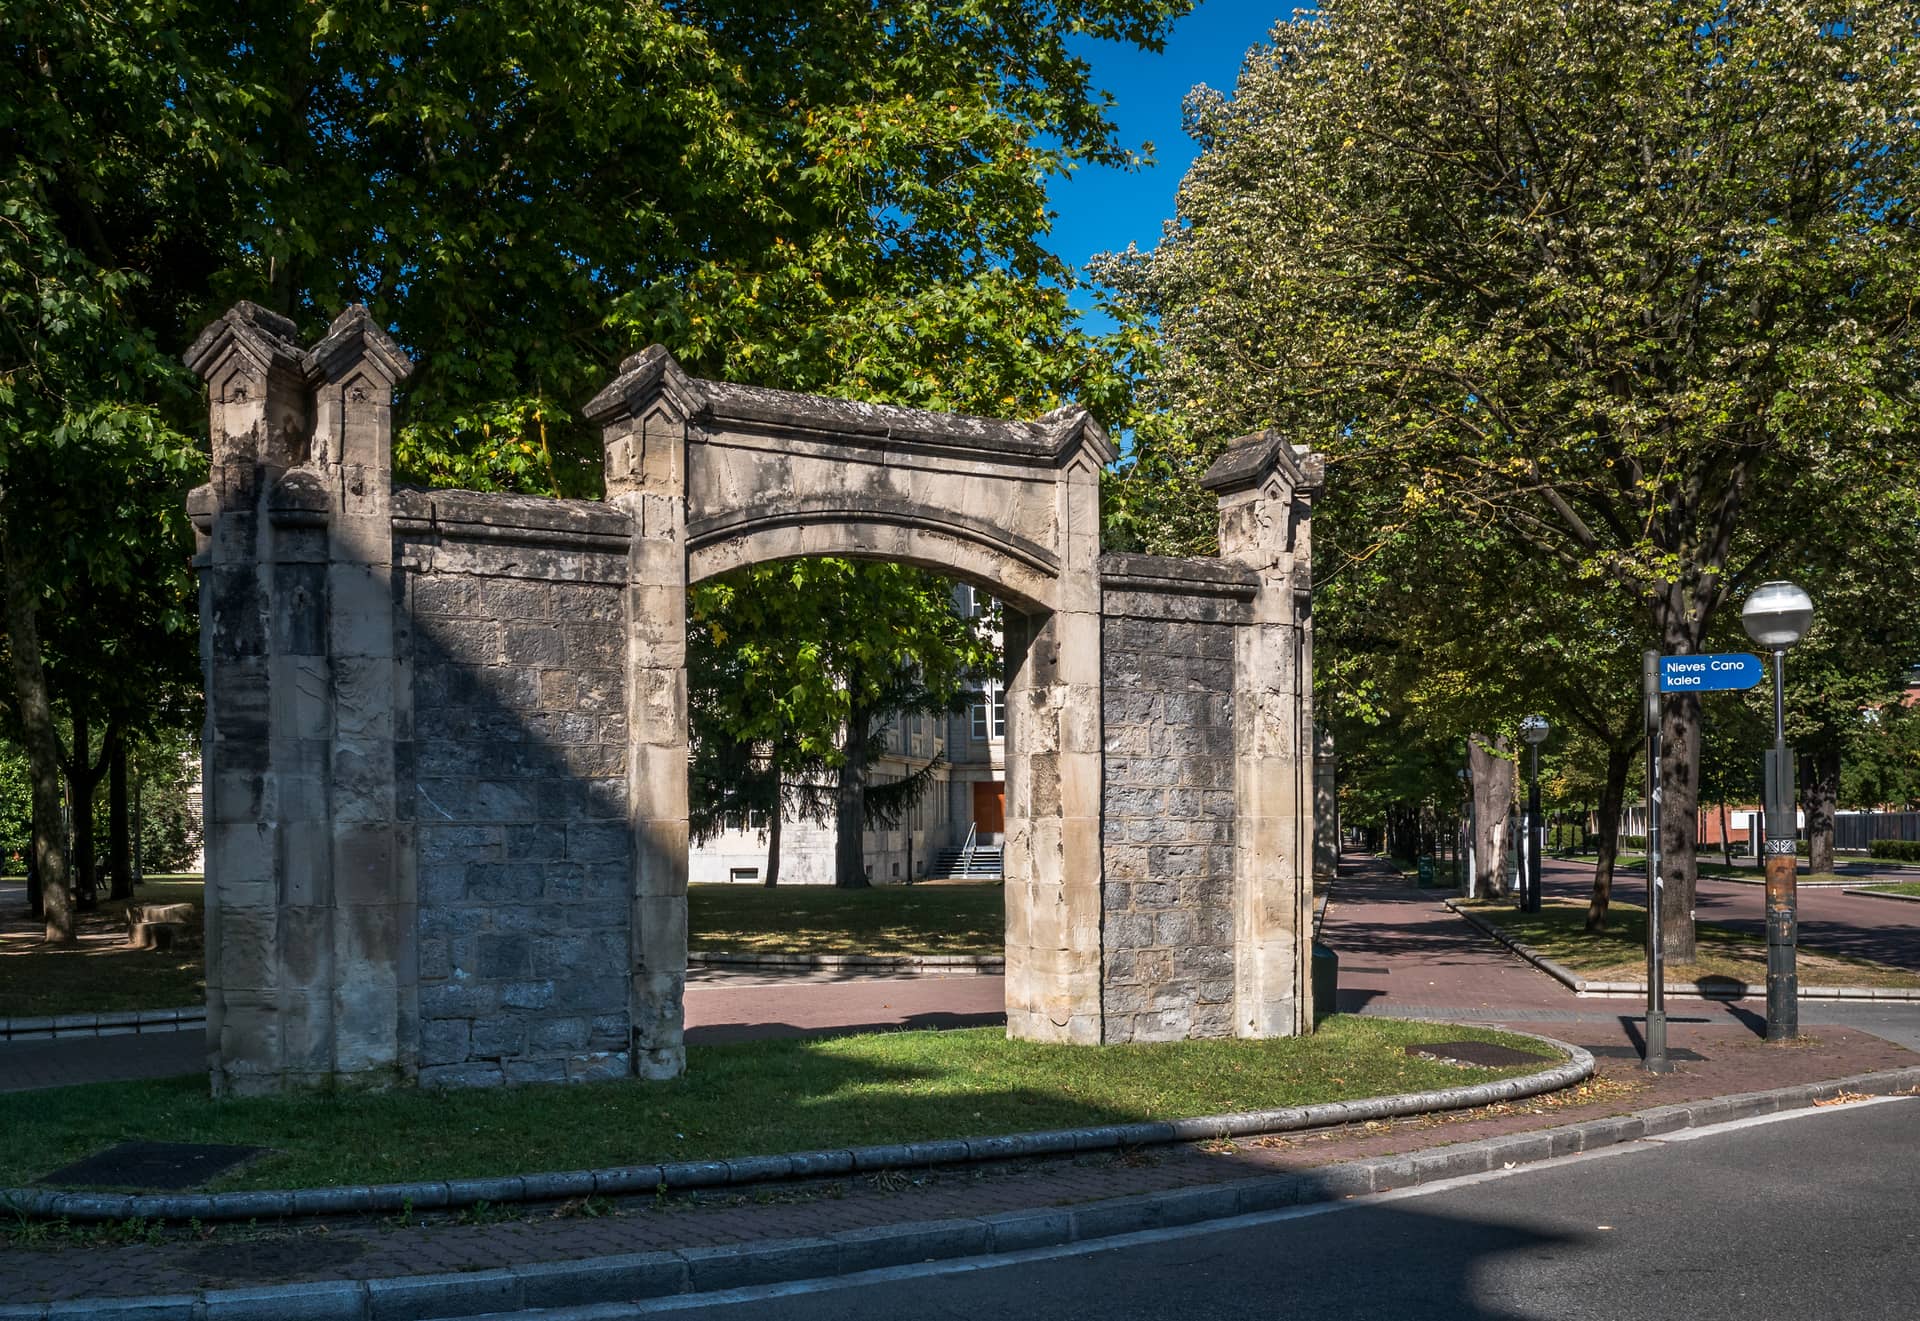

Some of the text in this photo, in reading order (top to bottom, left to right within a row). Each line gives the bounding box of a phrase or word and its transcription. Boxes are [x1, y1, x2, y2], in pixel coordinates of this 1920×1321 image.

[1667, 661, 1745, 673] Nieves Cano
[1667, 676, 1701, 686] kalea
